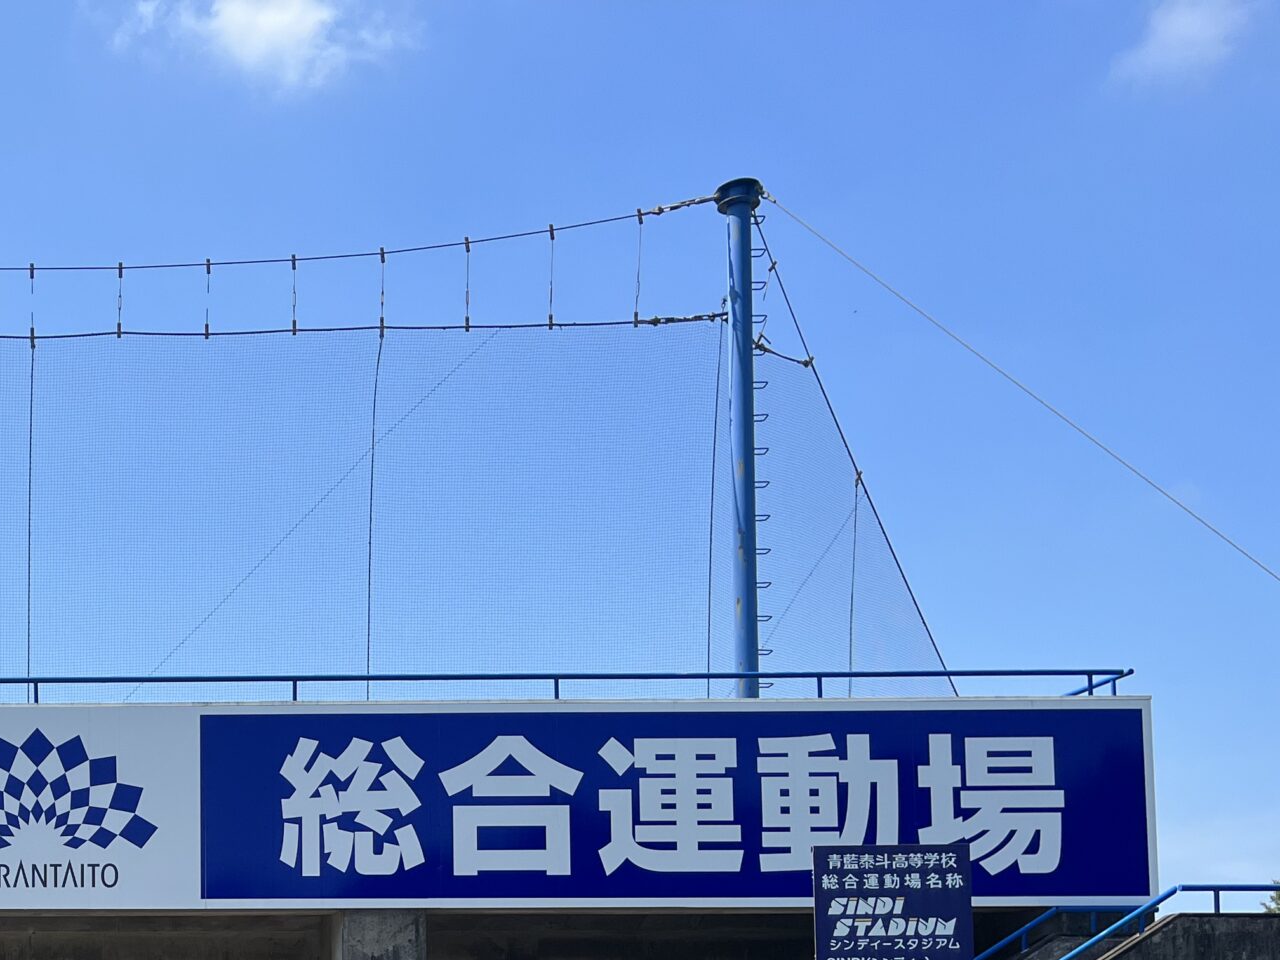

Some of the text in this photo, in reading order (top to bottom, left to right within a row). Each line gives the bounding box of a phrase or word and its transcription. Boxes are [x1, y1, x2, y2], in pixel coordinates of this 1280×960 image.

[279, 732, 1066, 878] 総合運動場
[827, 852, 957, 870] 青藍泰斗高等学校
[821, 872, 964, 890] 総合運動場名称
[827, 896, 905, 915] SINDI
[832, 917, 957, 937] STADIUM
[829, 938, 961, 951] シンディースタジアム
